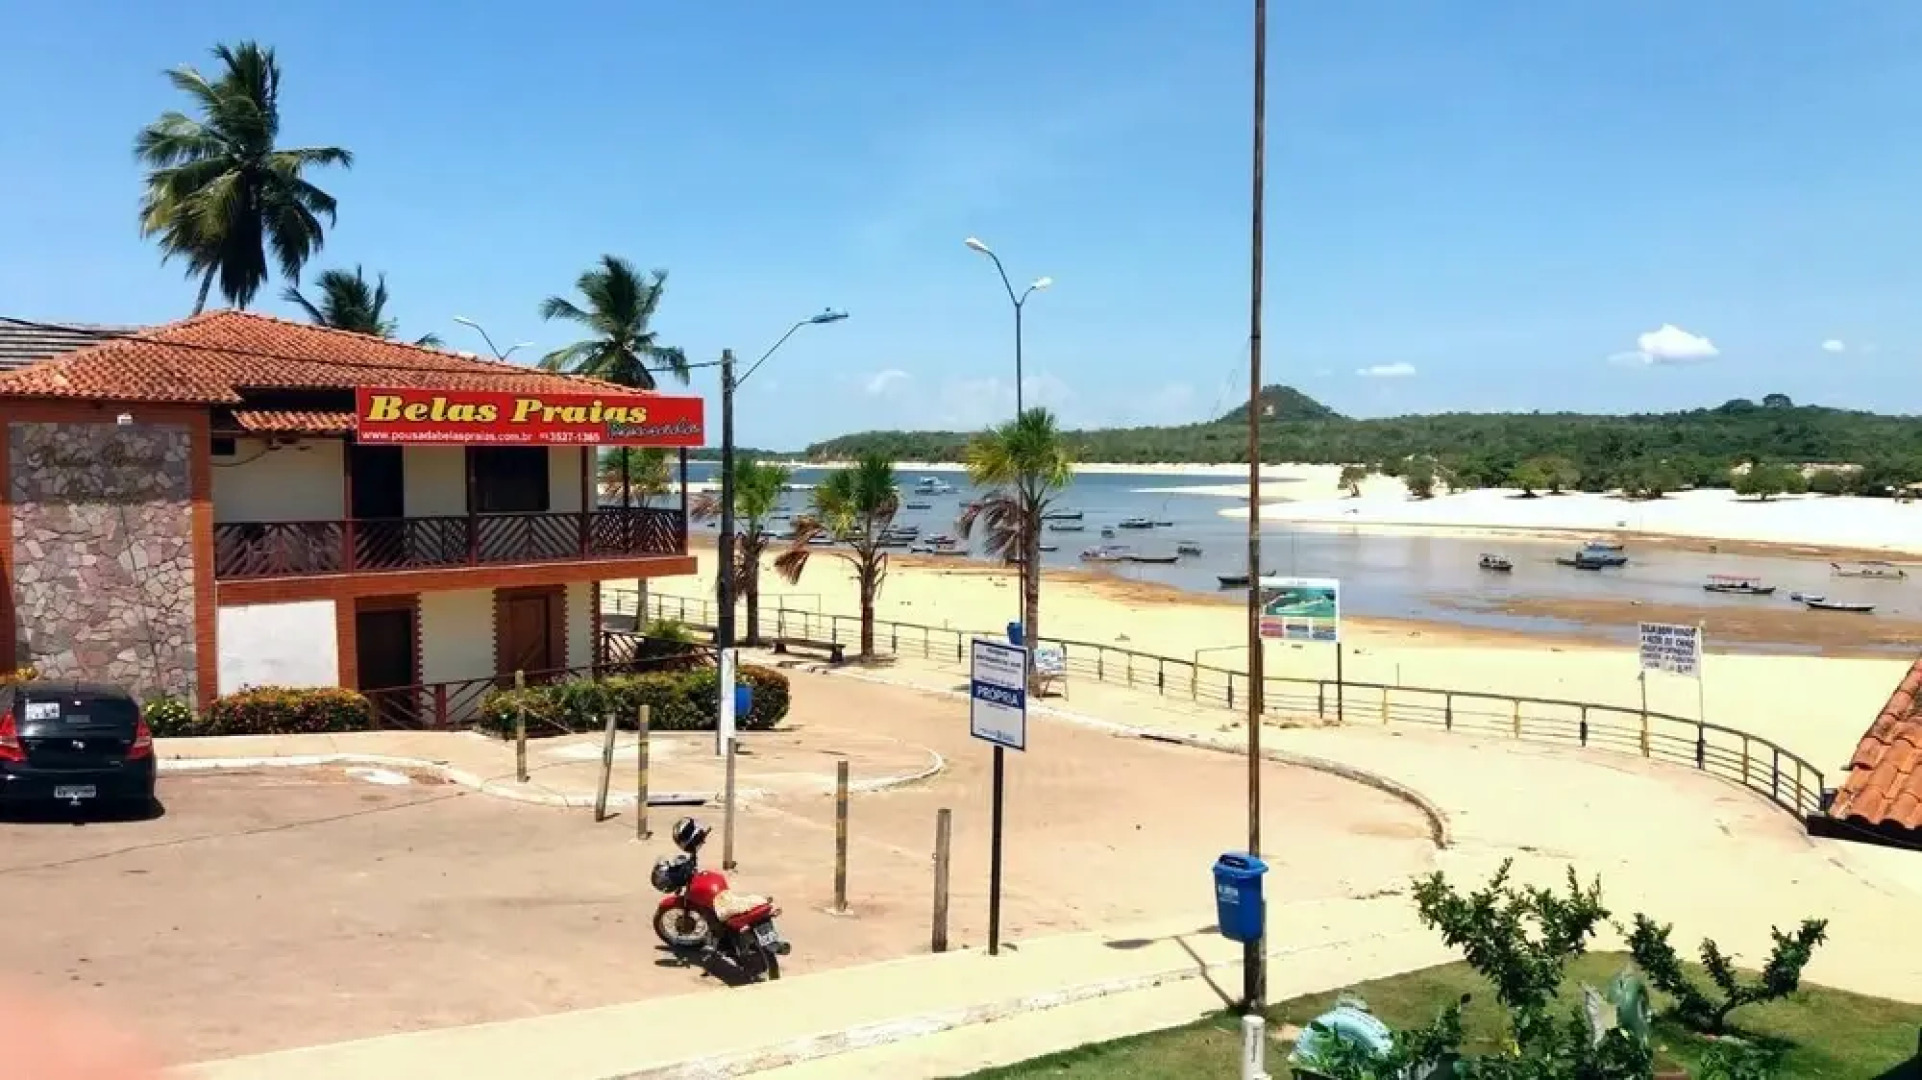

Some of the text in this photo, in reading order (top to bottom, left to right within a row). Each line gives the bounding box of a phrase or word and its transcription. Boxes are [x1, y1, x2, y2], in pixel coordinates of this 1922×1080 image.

[366, 395, 647, 424] Belas Praias
[362, 430, 533, 442] www.pousadabelaspraias.com.br
[977, 685, 1019, 707] PRÓPRIA
